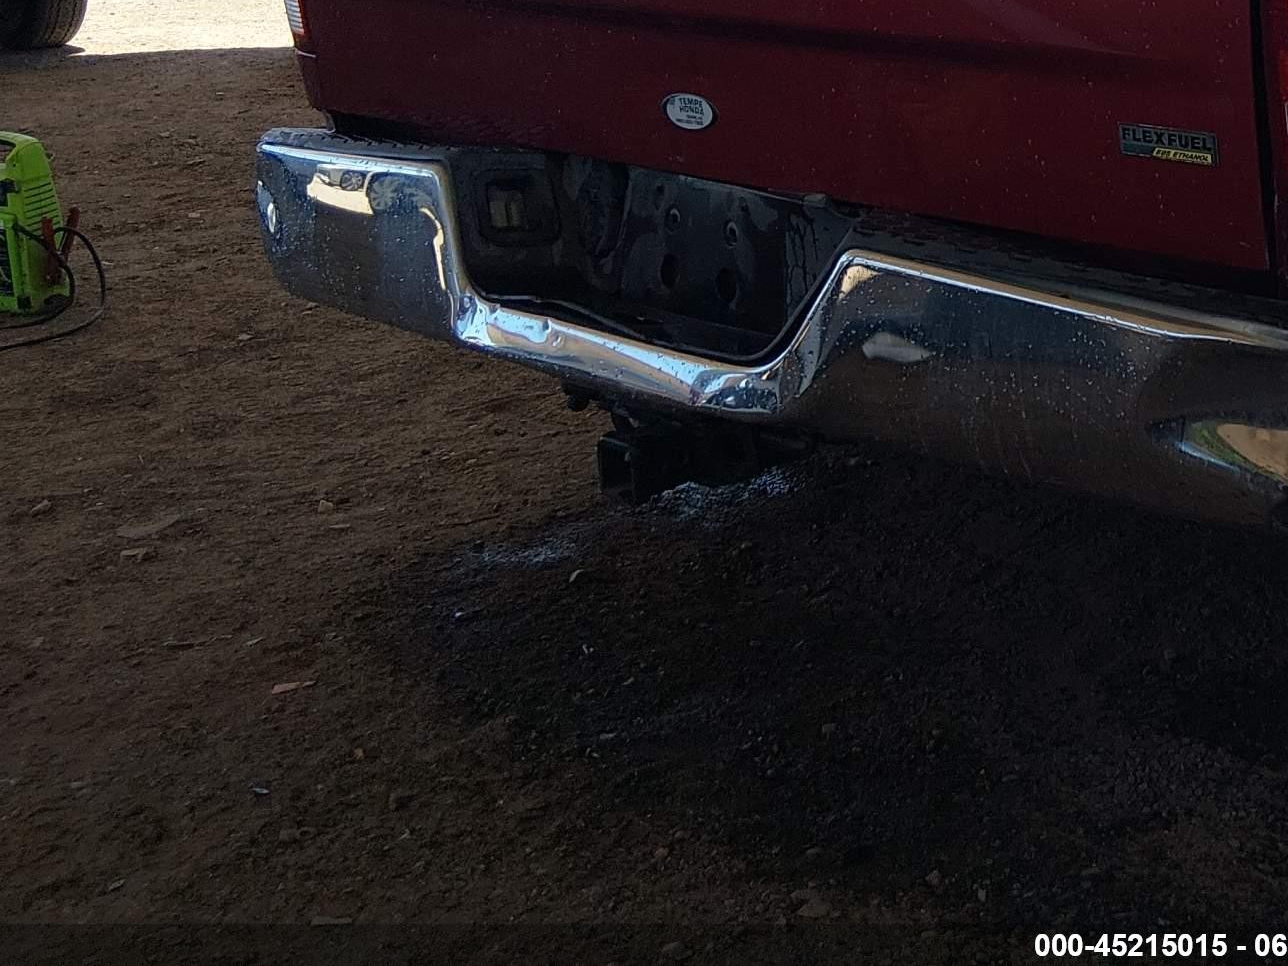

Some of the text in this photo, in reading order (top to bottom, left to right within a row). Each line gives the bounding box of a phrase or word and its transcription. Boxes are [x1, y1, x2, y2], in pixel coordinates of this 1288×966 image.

[678, 98, 703, 108] TEMPE
[679, 105, 705, 116] HONDA
[1173, 152, 1209, 162] ETHANOL
